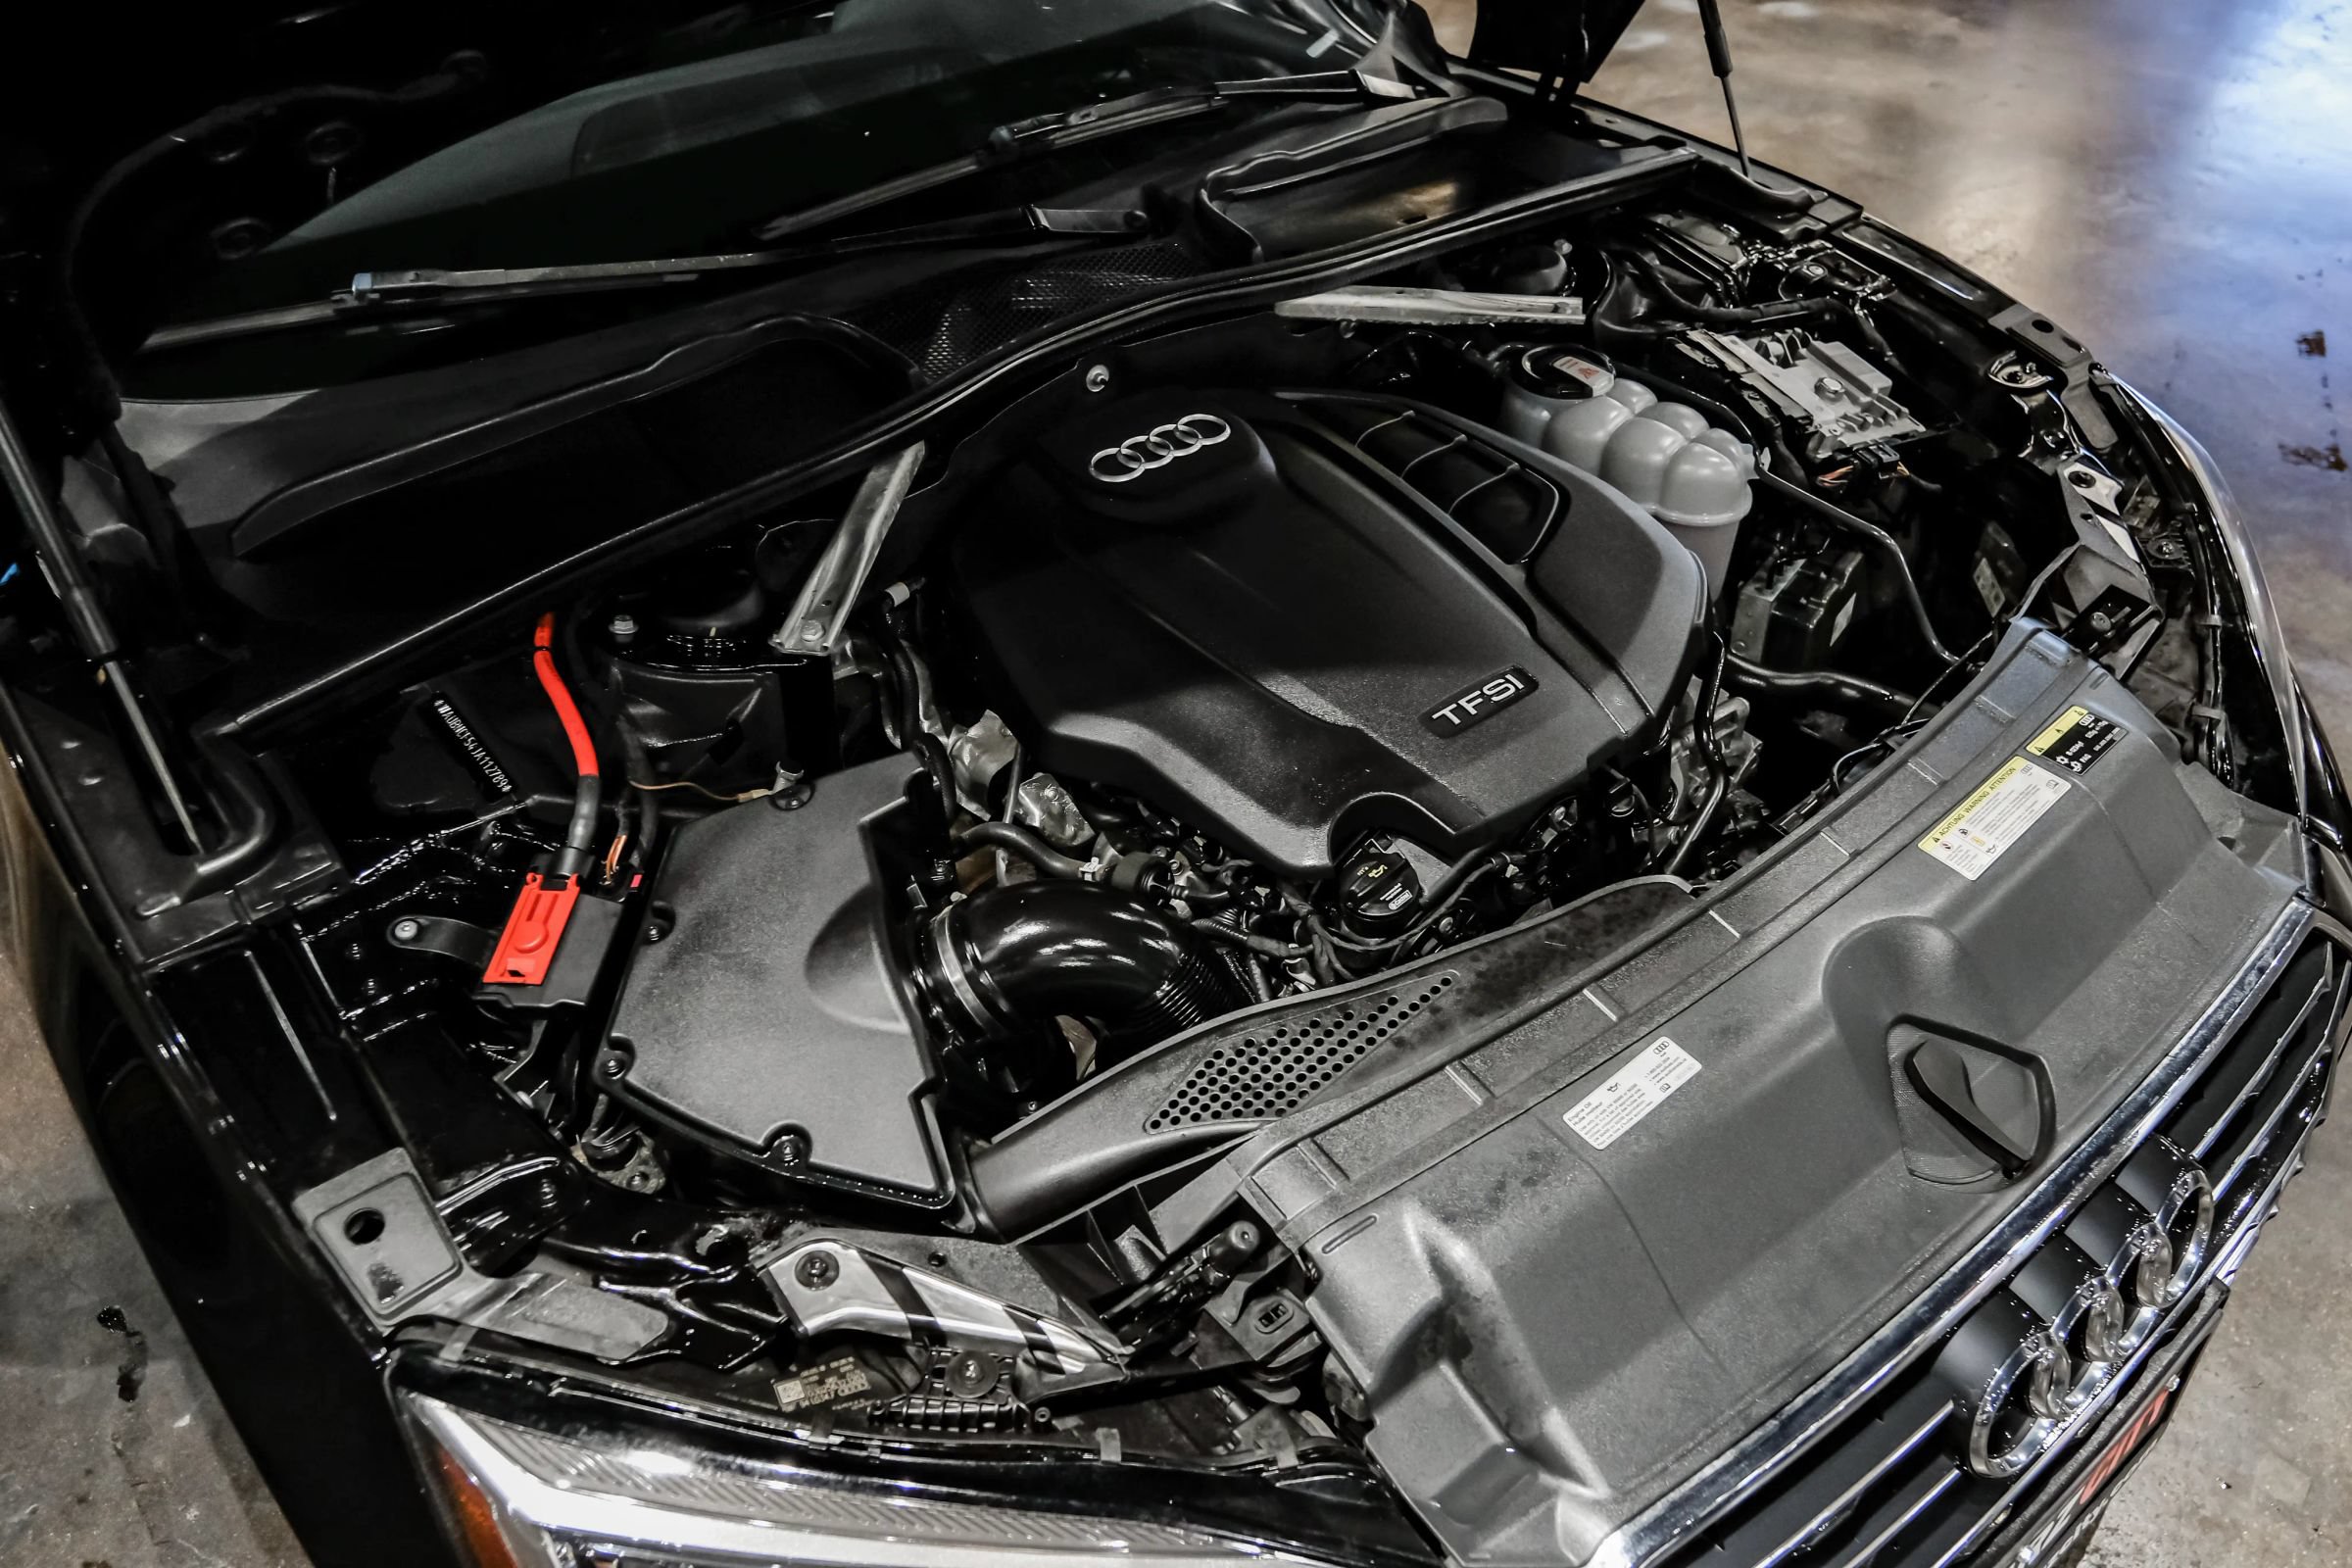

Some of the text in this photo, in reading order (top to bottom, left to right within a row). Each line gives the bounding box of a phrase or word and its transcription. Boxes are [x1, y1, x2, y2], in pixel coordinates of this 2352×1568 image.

[1432, 674, 1525, 725] TFSI
[1938, 812, 1966, 837] ACHTUNG
[1964, 790, 1990, 814] WARNING
[1989, 766, 2017, 791] ATTENTION
